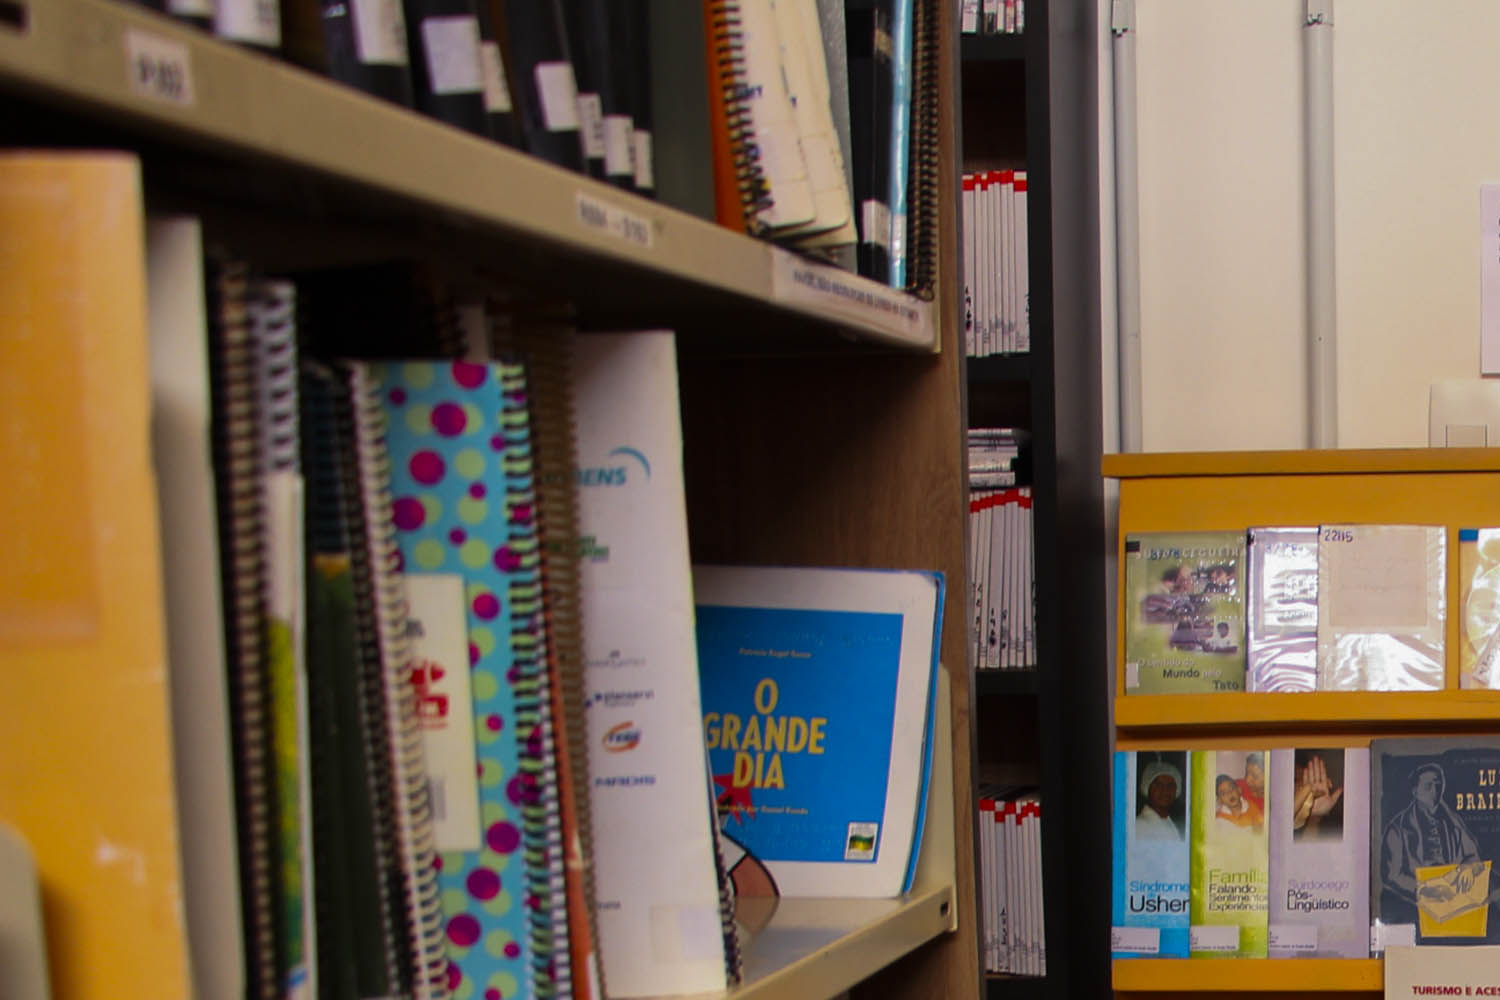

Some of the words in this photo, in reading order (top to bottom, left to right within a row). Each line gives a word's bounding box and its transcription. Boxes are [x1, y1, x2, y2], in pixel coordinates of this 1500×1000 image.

[1162, 668, 1200, 680] Mundo
[1213, 680, 1240, 691] Tato
[754, 677, 779, 714] O
[703, 713, 828, 754] GRANDE
[732, 752, 785, 789] DIA
[1129, 879, 1189, 893] Síndrome
[1208, 883, 1257, 894] Falando
[1286, 889, 1313, 901] Pós-
[1129, 895, 1190, 913] Usher
[1286, 898, 1350, 913] Lingüístico
[1412, 985, 1462, 996] TURISMO
[1465, 986, 1472, 996] E
